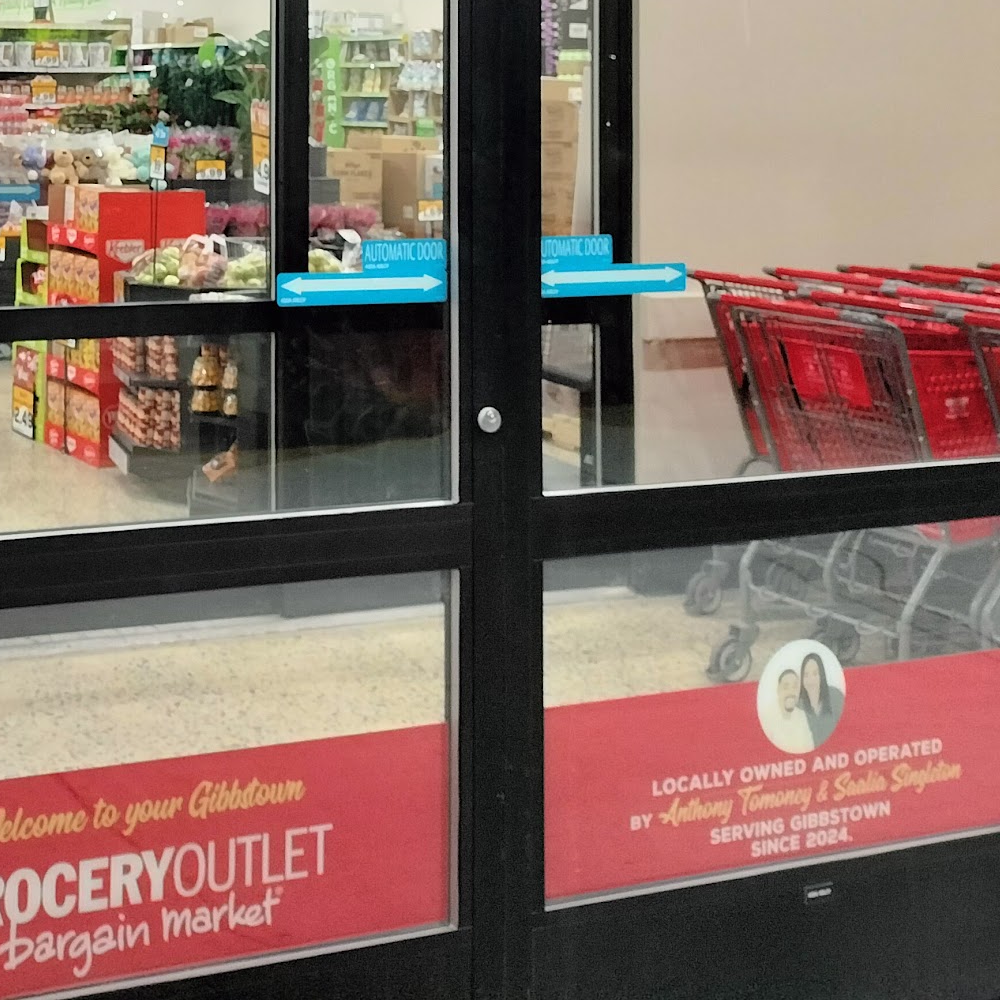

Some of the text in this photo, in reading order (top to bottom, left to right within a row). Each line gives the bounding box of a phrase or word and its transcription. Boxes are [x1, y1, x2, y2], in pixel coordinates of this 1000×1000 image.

[365, 242, 444, 261] AUTOMATIC DOOR
[542, 237, 609, 257] UTOMATIC DOOR
[652, 738, 943, 797] LOCALLY OWNED AND OPERATED
[93, 798, 120, 829] to
[122, 796, 184, 836] your
[188, 776, 306, 819] Gibbstown
[630, 813, 653, 831] BY
[659, 798, 733, 827] Anthony
[816, 780, 828, 803] &
[890, 760, 962, 794] Singleton
[710, 801, 891, 845] SERVING GIBBSTOWN
[751, 834, 801, 857] SINCE
[161, 886, 281, 942] market
